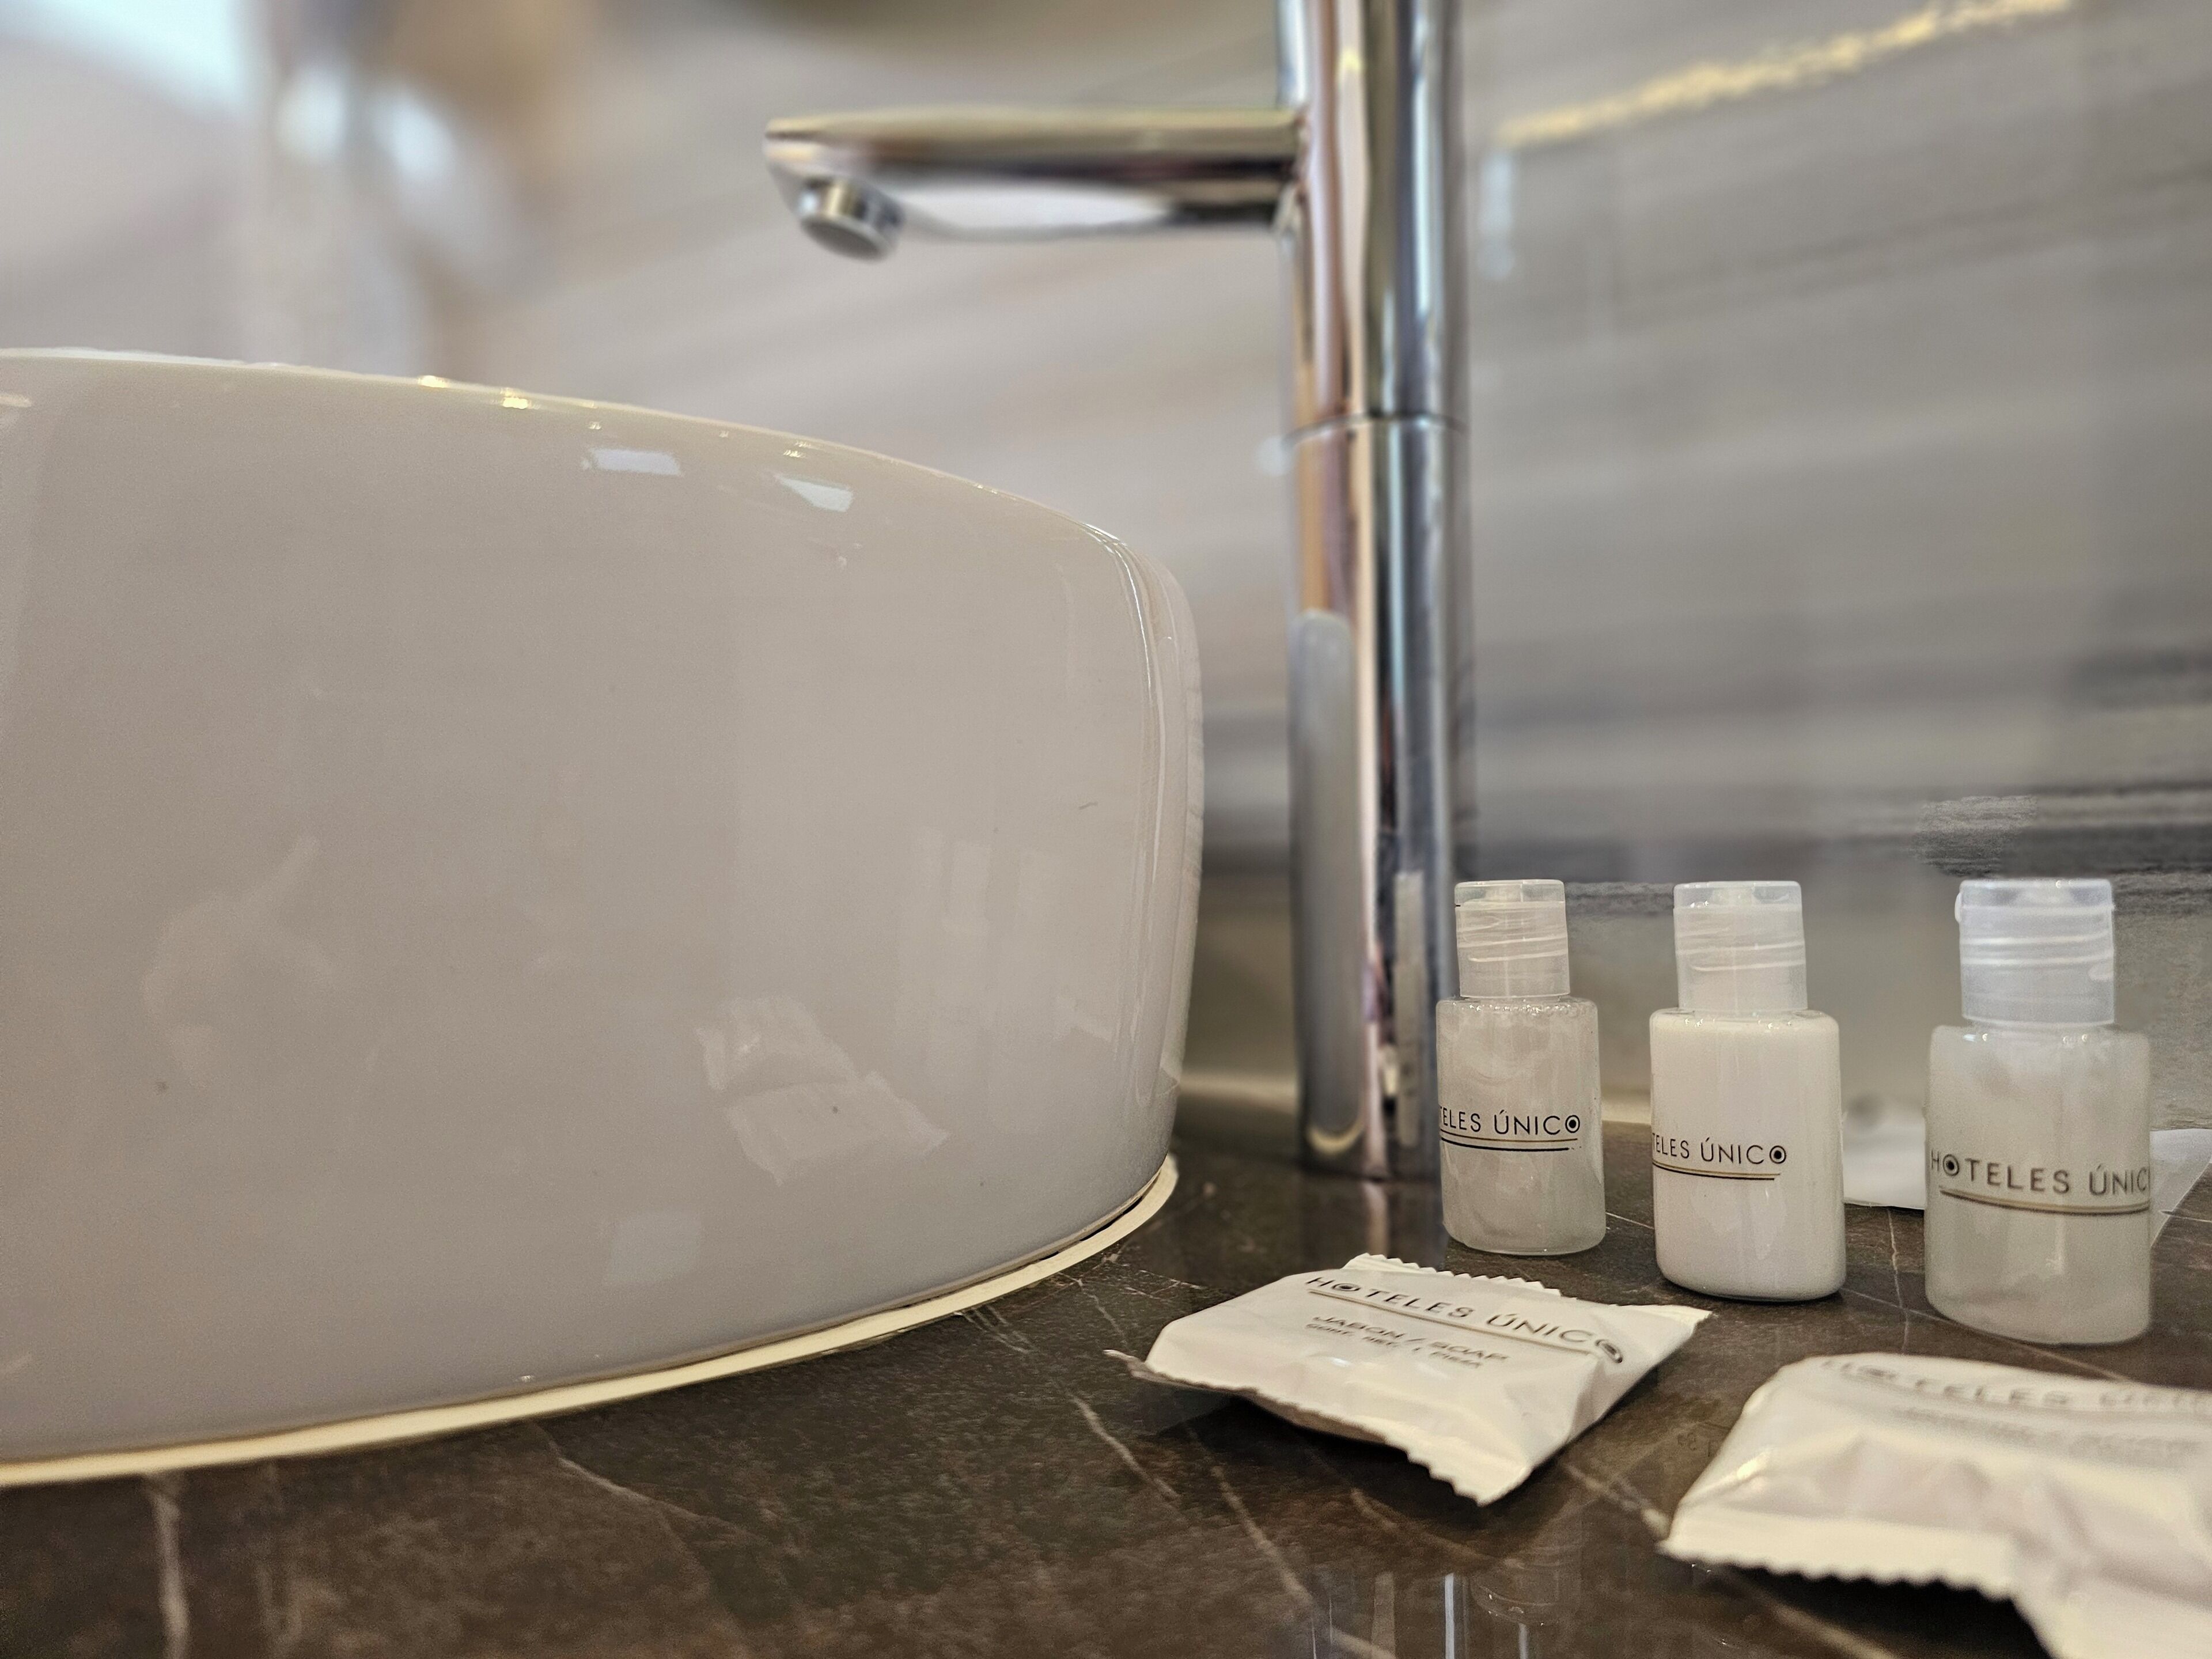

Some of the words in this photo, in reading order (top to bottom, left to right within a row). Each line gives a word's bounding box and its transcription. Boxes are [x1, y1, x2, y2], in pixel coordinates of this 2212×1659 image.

[1494, 1109, 1581, 1136] ÚNICO
[1700, 1137, 1787, 1165] ÚNICO
[1930, 1149, 2070, 1195] HOTELES
[2088, 1162, 2150, 1196] ÚNIC
[1305, 1277, 1475, 1319] HOTELES
[1486, 1313, 1624, 1364] ÚNICO
[1429, 1341, 1509, 1359] SOAP
